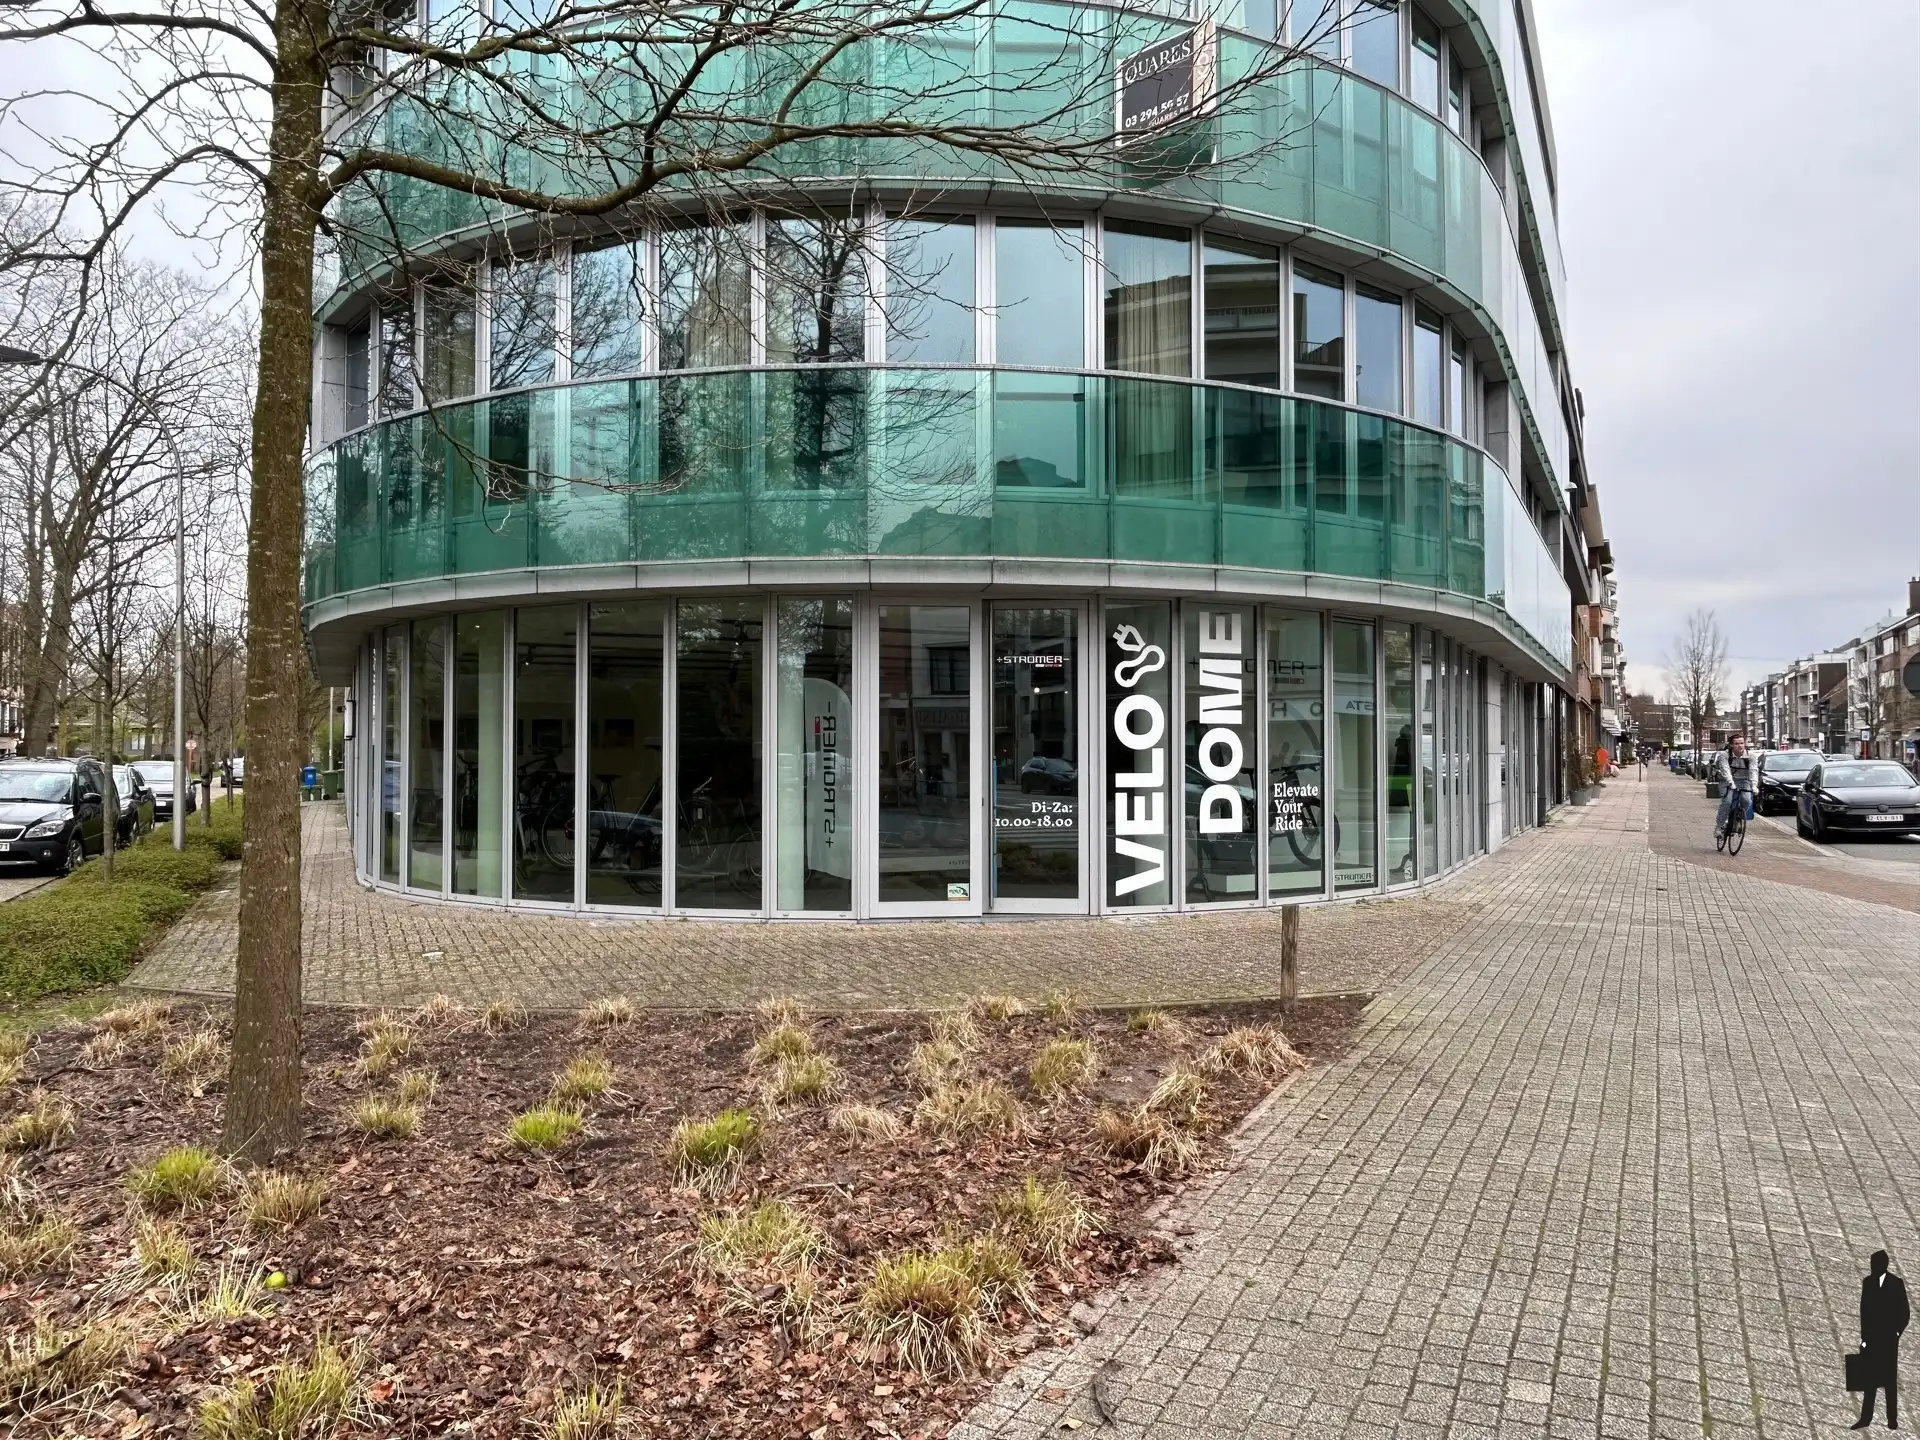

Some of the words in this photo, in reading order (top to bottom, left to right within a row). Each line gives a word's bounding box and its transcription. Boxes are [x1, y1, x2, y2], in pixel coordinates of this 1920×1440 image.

[1125, 40, 1191, 84] QUARES
[1125, 115, 1138, 128] 03
[1139, 106, 1158, 122] 294
[1176, 92, 1190, 107] 57
[1199, 612, 1243, 833] DOME
[1114, 694, 1165, 896] VELO
[1273, 781, 1319, 797] Elevate
[1031, 801, 1073, 813] Di-Za:
[1274, 799, 1303, 813] Your
[994, 815, 1073, 827] 10.00-18.00
[1275, 814, 1303, 831] Ride
